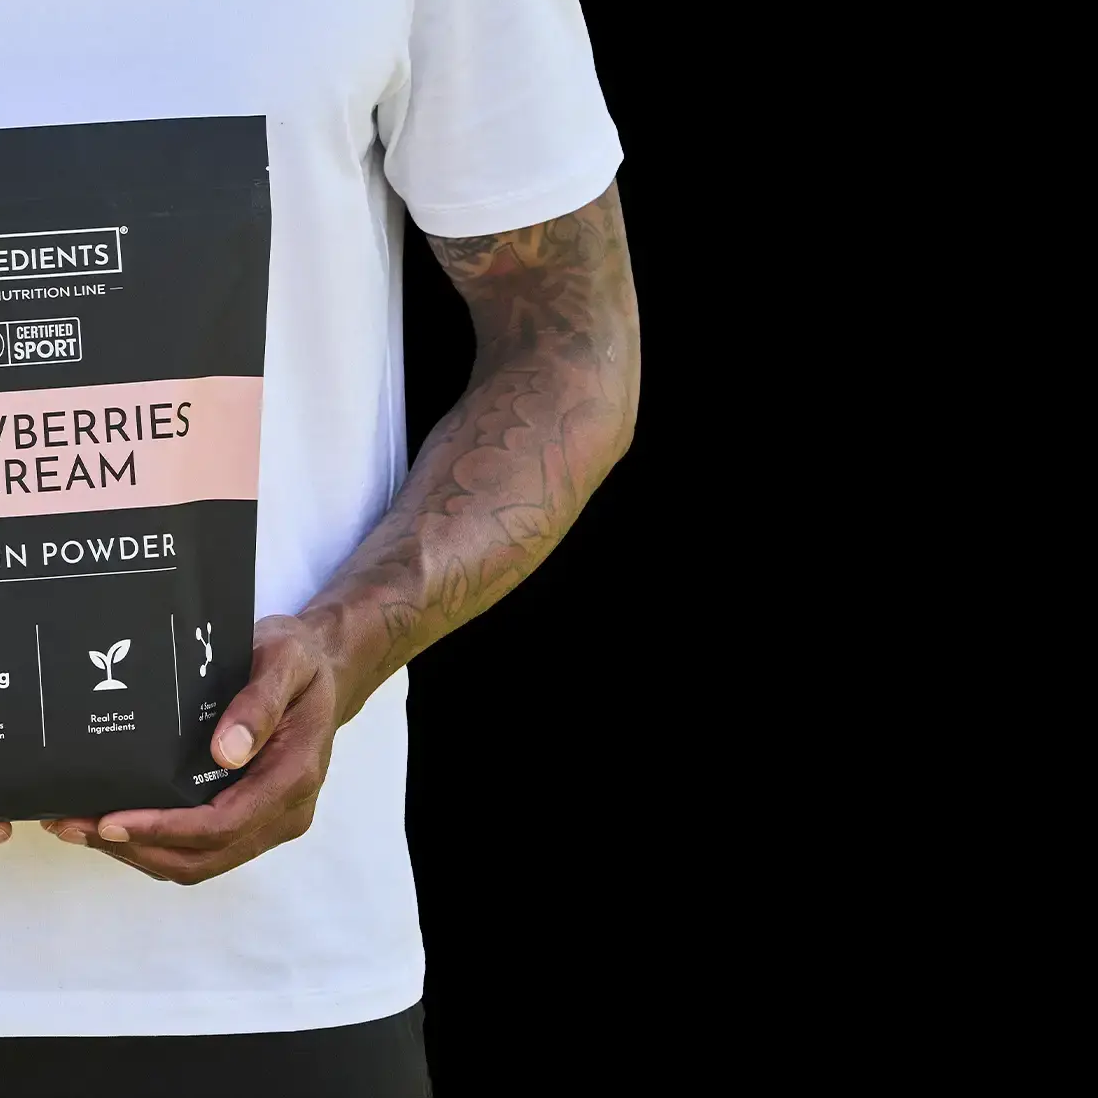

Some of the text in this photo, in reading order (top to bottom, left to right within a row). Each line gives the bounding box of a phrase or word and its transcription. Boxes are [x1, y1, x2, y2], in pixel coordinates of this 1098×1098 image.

[74, 284, 106, 297] LINE
[16, 323, 73, 340] CERTIFIED
[13, 338, 77, 361] SPORT
[42, 533, 177, 565] POWDER
[90, 710, 135, 723] Real Food
[87, 723, 136, 735] Ingredients
[193, 774, 204, 785] 20
